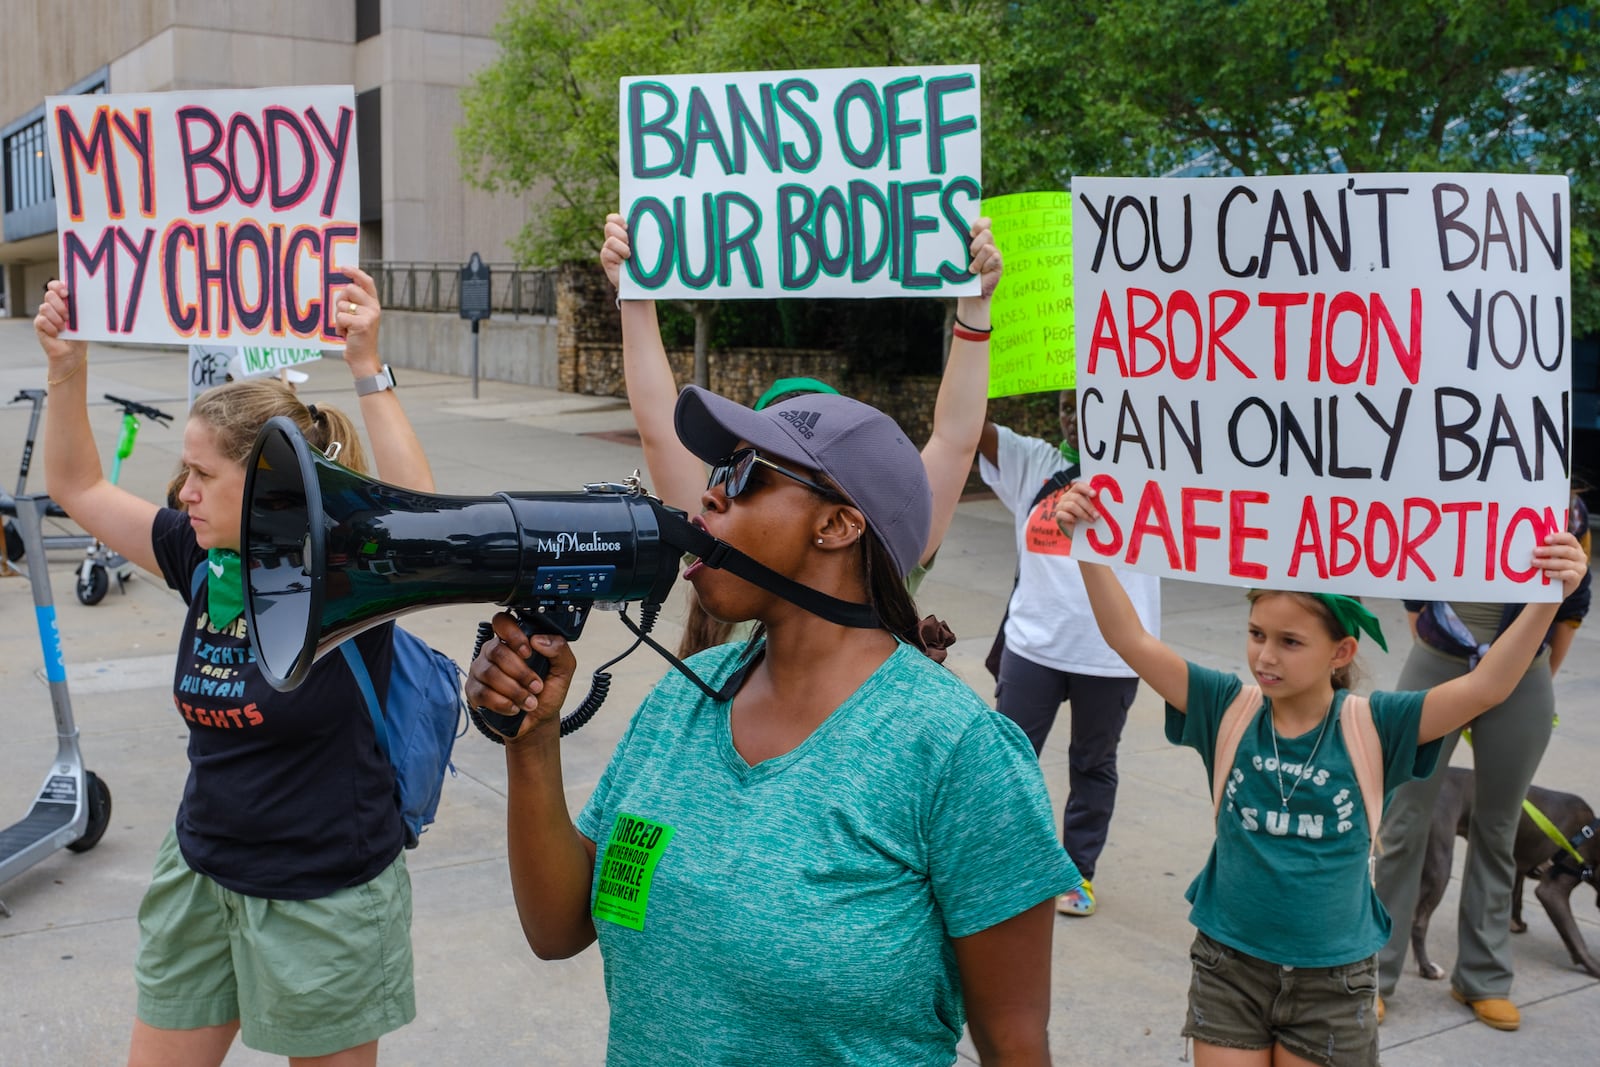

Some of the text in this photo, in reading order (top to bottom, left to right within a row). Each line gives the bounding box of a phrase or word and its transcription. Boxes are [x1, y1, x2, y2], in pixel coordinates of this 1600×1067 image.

[54, 104, 354, 222] MY BODY
[628, 73, 977, 179] BANS OFF
[625, 175, 982, 291] OUR BODIES
[1080, 178, 1563, 278] YOU CAN'T BAN
[63, 219, 359, 343] MY CHOICE
[1087, 287, 1564, 386] ABORTION YOU
[778, 411, 814, 440] adidas
[1080, 386, 1568, 481] CAN ONLY BAN
[1085, 473, 1269, 579] SAFE
[179, 674, 246, 698] HUMAN
[1240, 807, 1324, 839] SUN
[1333, 789, 1354, 833] the
[608, 860, 645, 887] FEMALE
